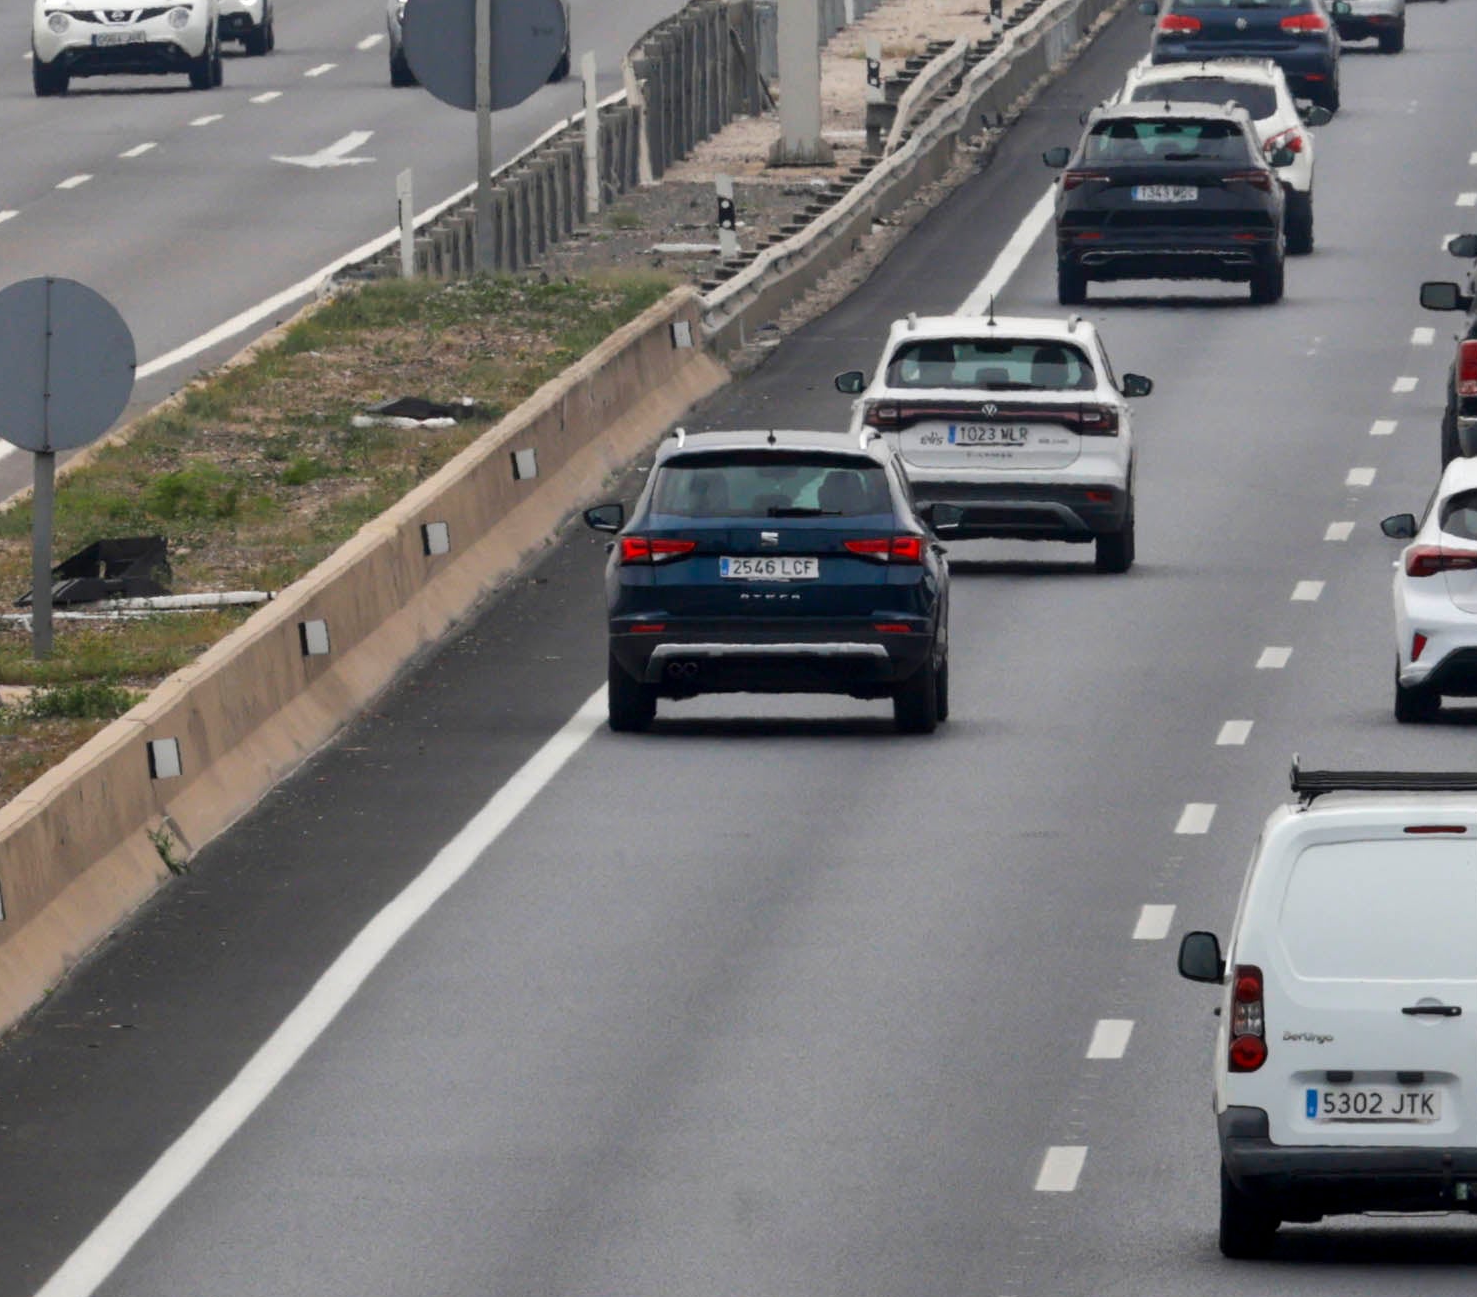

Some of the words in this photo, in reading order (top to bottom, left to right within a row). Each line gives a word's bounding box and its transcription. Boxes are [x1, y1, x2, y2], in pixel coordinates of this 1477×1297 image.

[959, 426, 997, 442] 1023
[732, 559, 776, 576] 2546
[781, 558, 814, 576] LCF
[1322, 1092, 1383, 1116] 5302
[1391, 1092, 1436, 1117] JTK
